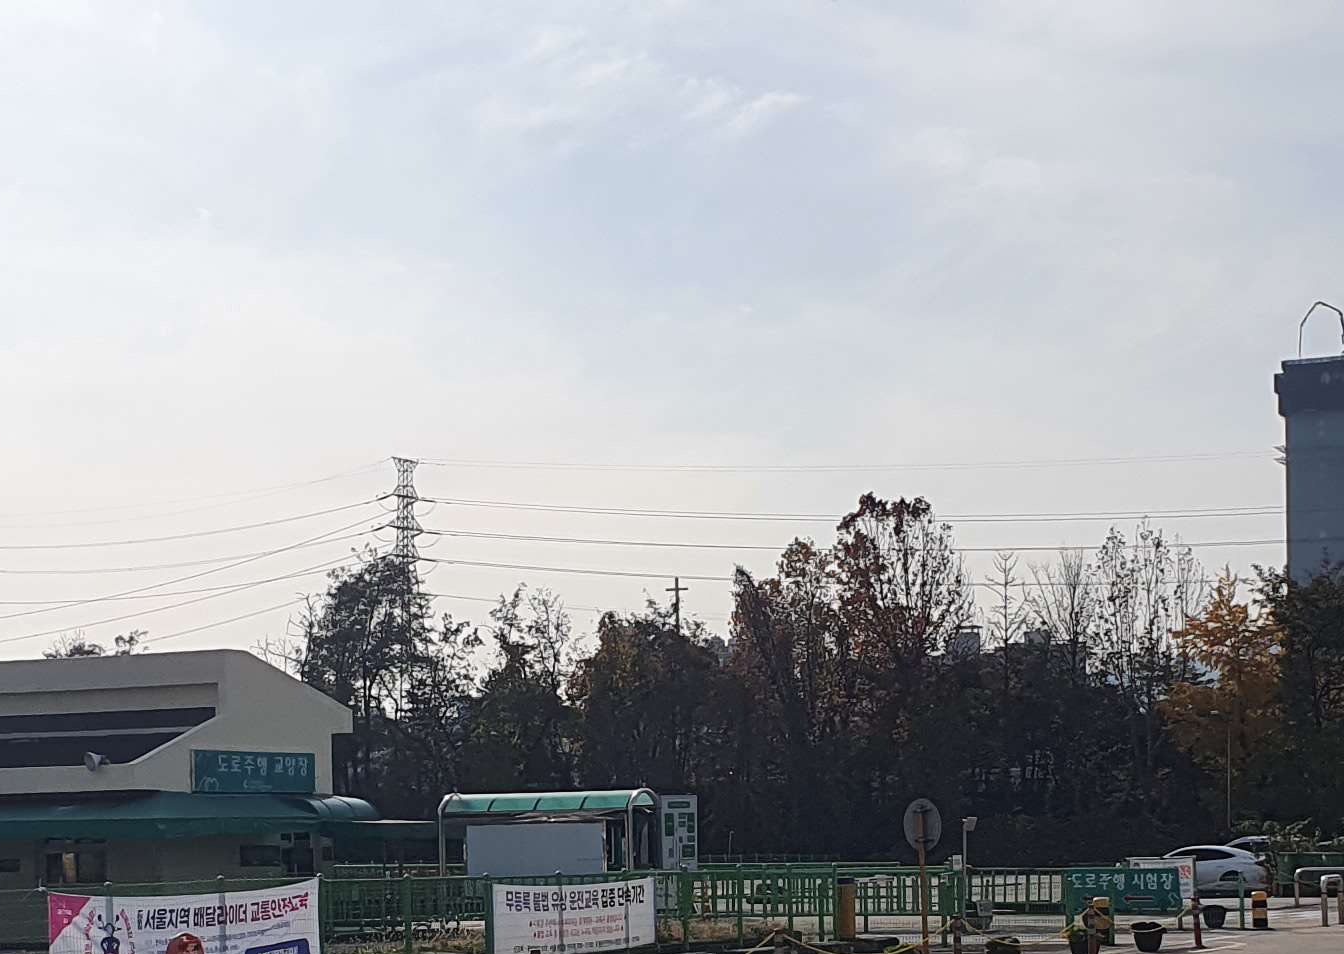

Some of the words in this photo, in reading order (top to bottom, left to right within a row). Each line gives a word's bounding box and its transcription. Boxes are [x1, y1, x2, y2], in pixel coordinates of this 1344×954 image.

[218, 754, 268, 777] 도로주행
[274, 756, 309, 777] 교양장
[1071, 873, 1125, 891] 도로주행
[1132, 872, 1174, 890] 시험장
[505, 890, 531, 913] 무등록
[533, 891, 550, 912] 불법
[551, 890, 567, 912] 유상
[569, 889, 599, 911] 운전교육
[600, 888, 616, 909] 집중
[144, 908, 191, 931] 서울지역
[193, 903, 248, 928] 배달라이더
